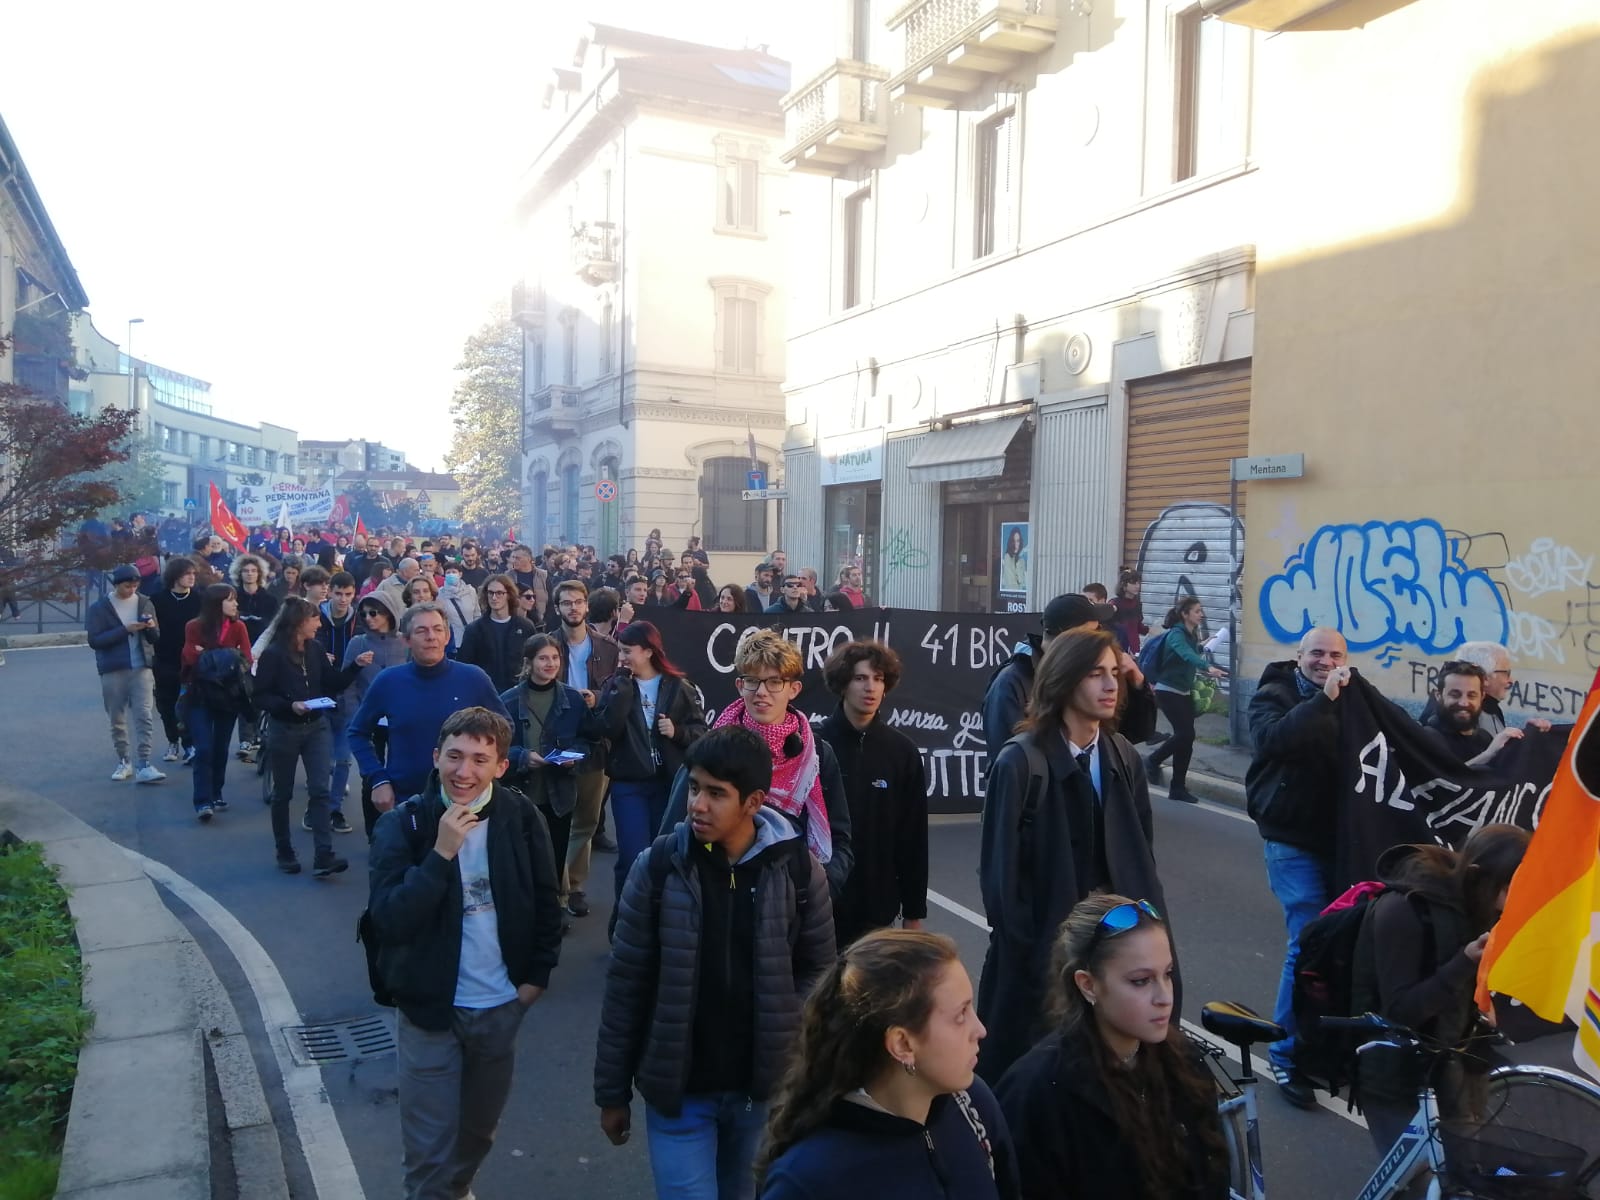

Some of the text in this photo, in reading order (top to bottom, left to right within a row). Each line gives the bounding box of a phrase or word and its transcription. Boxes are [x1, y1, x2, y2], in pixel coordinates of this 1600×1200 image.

[839, 449, 872, 466] NATURA
[1250, 464, 1287, 475] Mentana
[265, 489, 331, 502] PEDEMONTANA
[240, 506, 254, 515] NO
[920, 623, 959, 666] 41
[970, 625, 1011, 669] BIS
[887, 707, 988, 748] senza ga
[917, 747, 988, 798] UTTE
